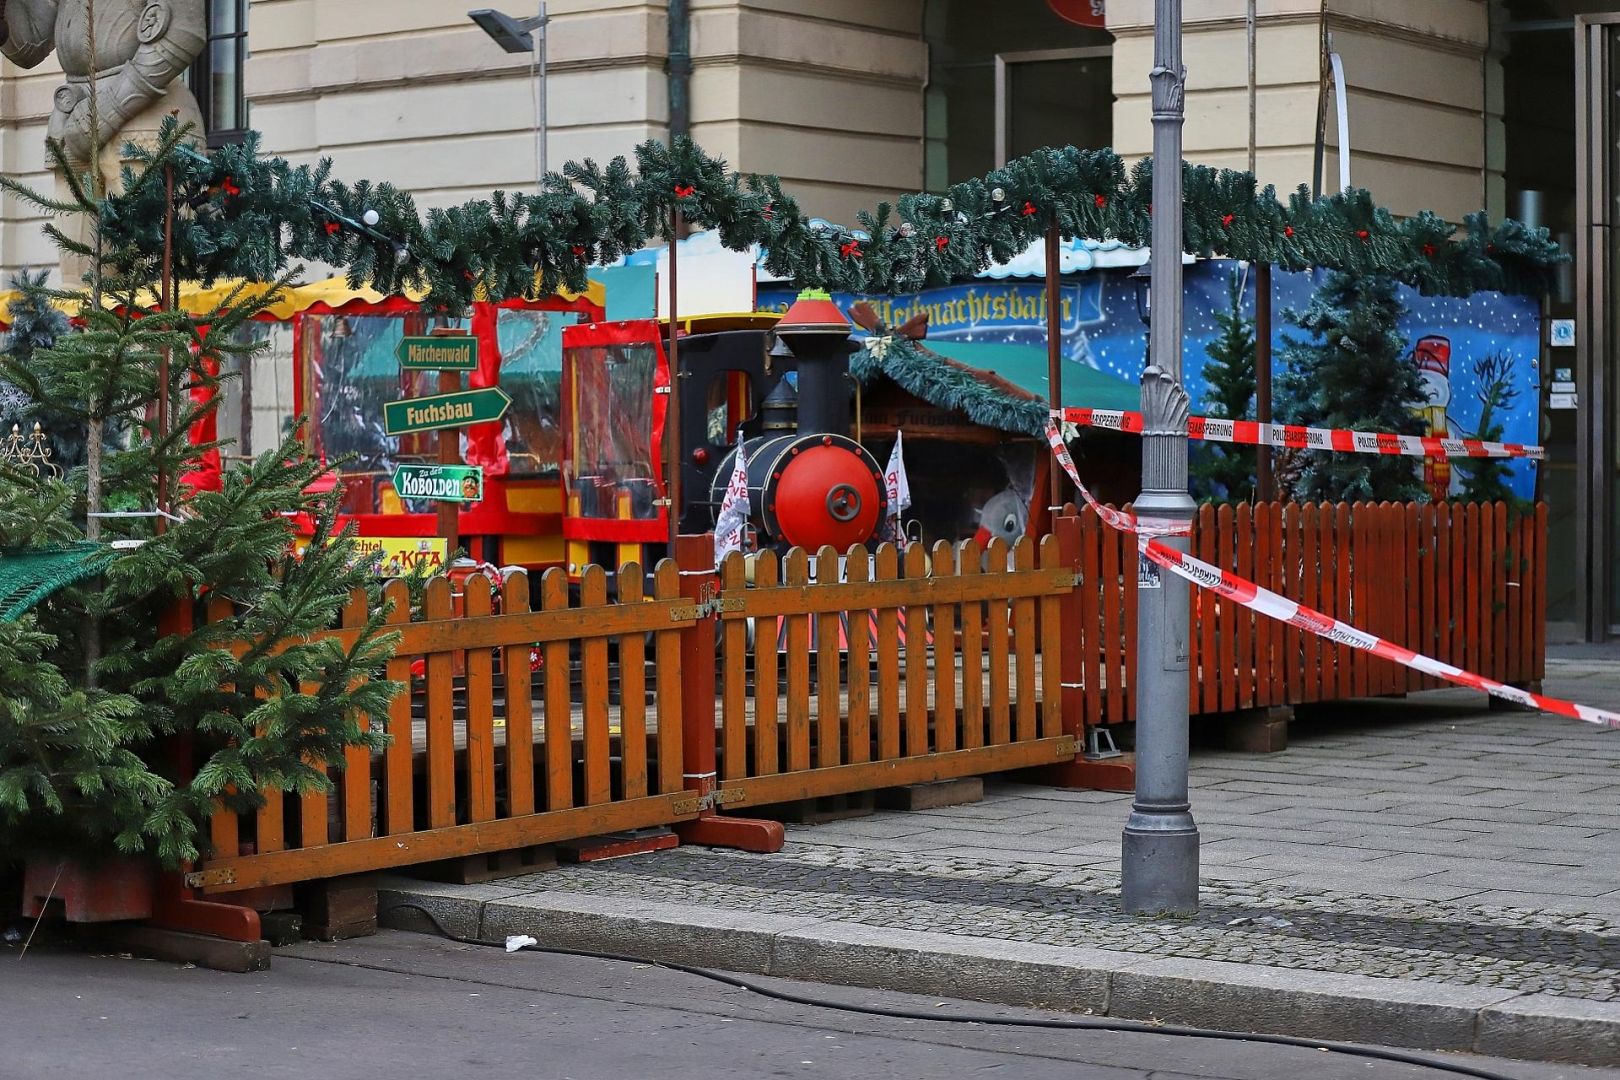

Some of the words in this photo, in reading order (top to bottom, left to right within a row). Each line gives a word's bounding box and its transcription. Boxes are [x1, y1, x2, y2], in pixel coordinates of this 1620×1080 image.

[408, 344, 470, 363] Märchenwald
[406, 402, 473, 425] Fuchsbau
[353, 539, 382, 556] chtel
